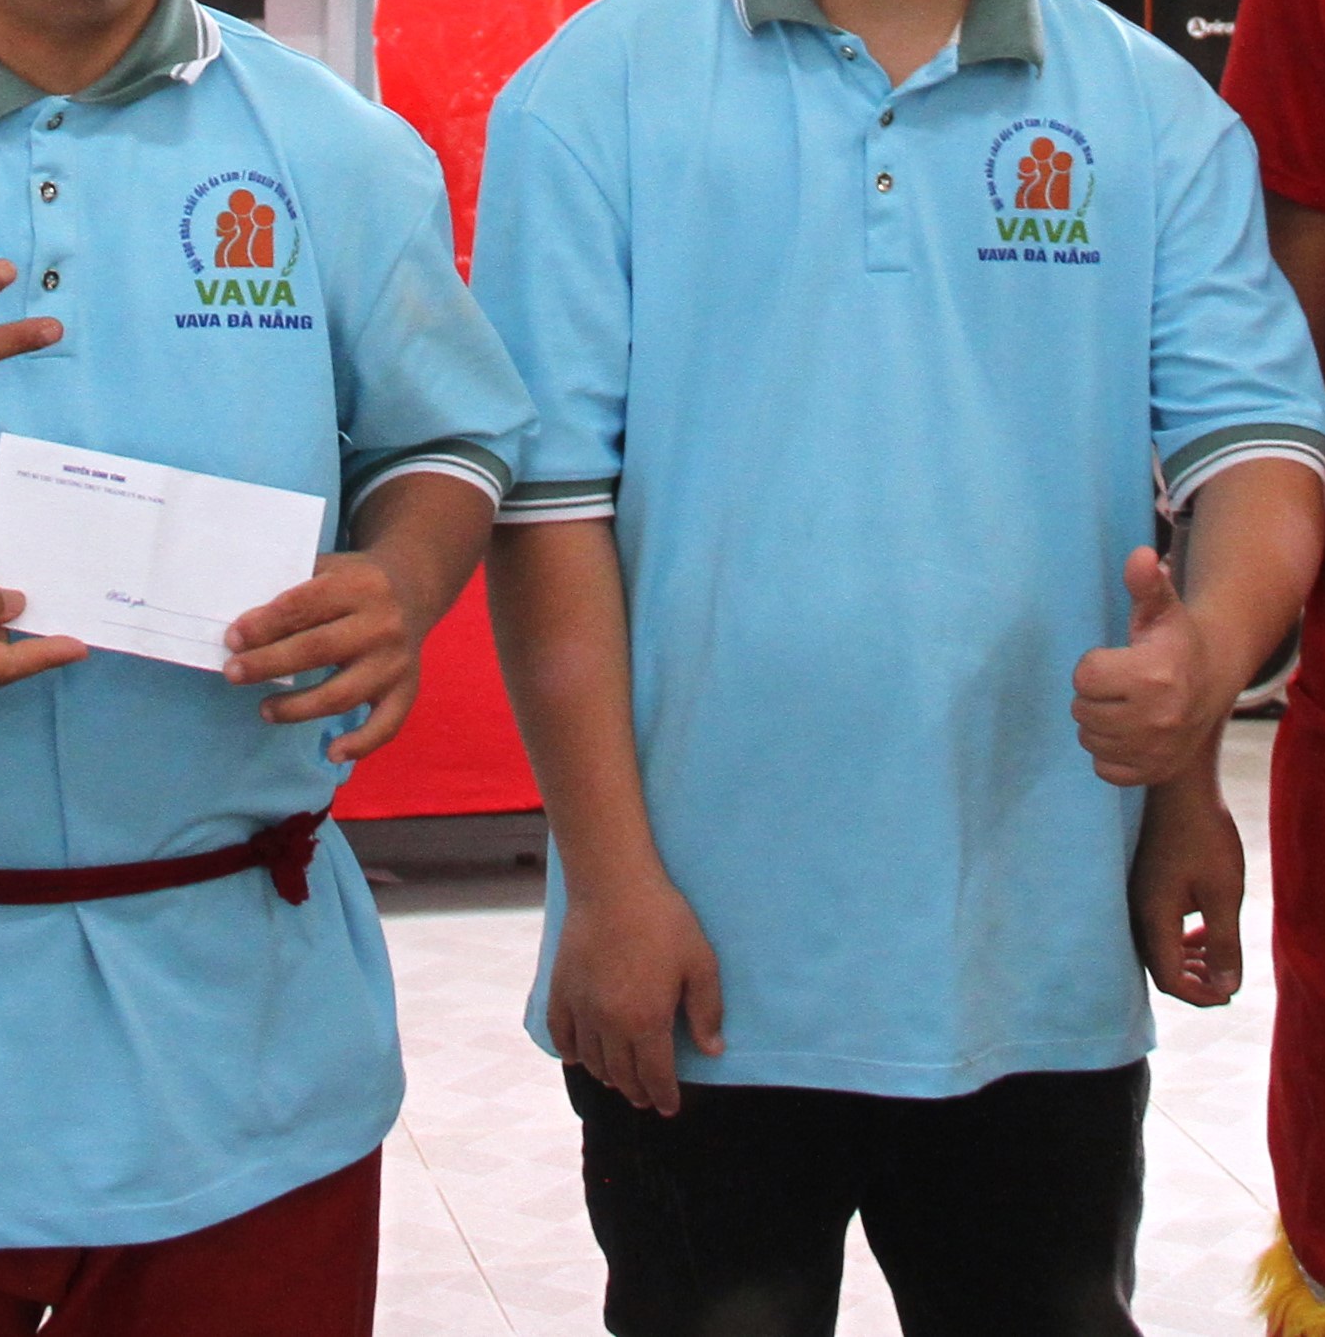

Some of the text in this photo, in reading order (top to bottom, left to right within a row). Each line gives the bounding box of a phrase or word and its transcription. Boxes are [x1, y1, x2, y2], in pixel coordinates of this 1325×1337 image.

[996, 217, 1089, 244] VAVA
[977, 247, 1018, 261] VAVA
[194, 279, 296, 306] VAVA
[175, 313, 221, 329] VAVA
